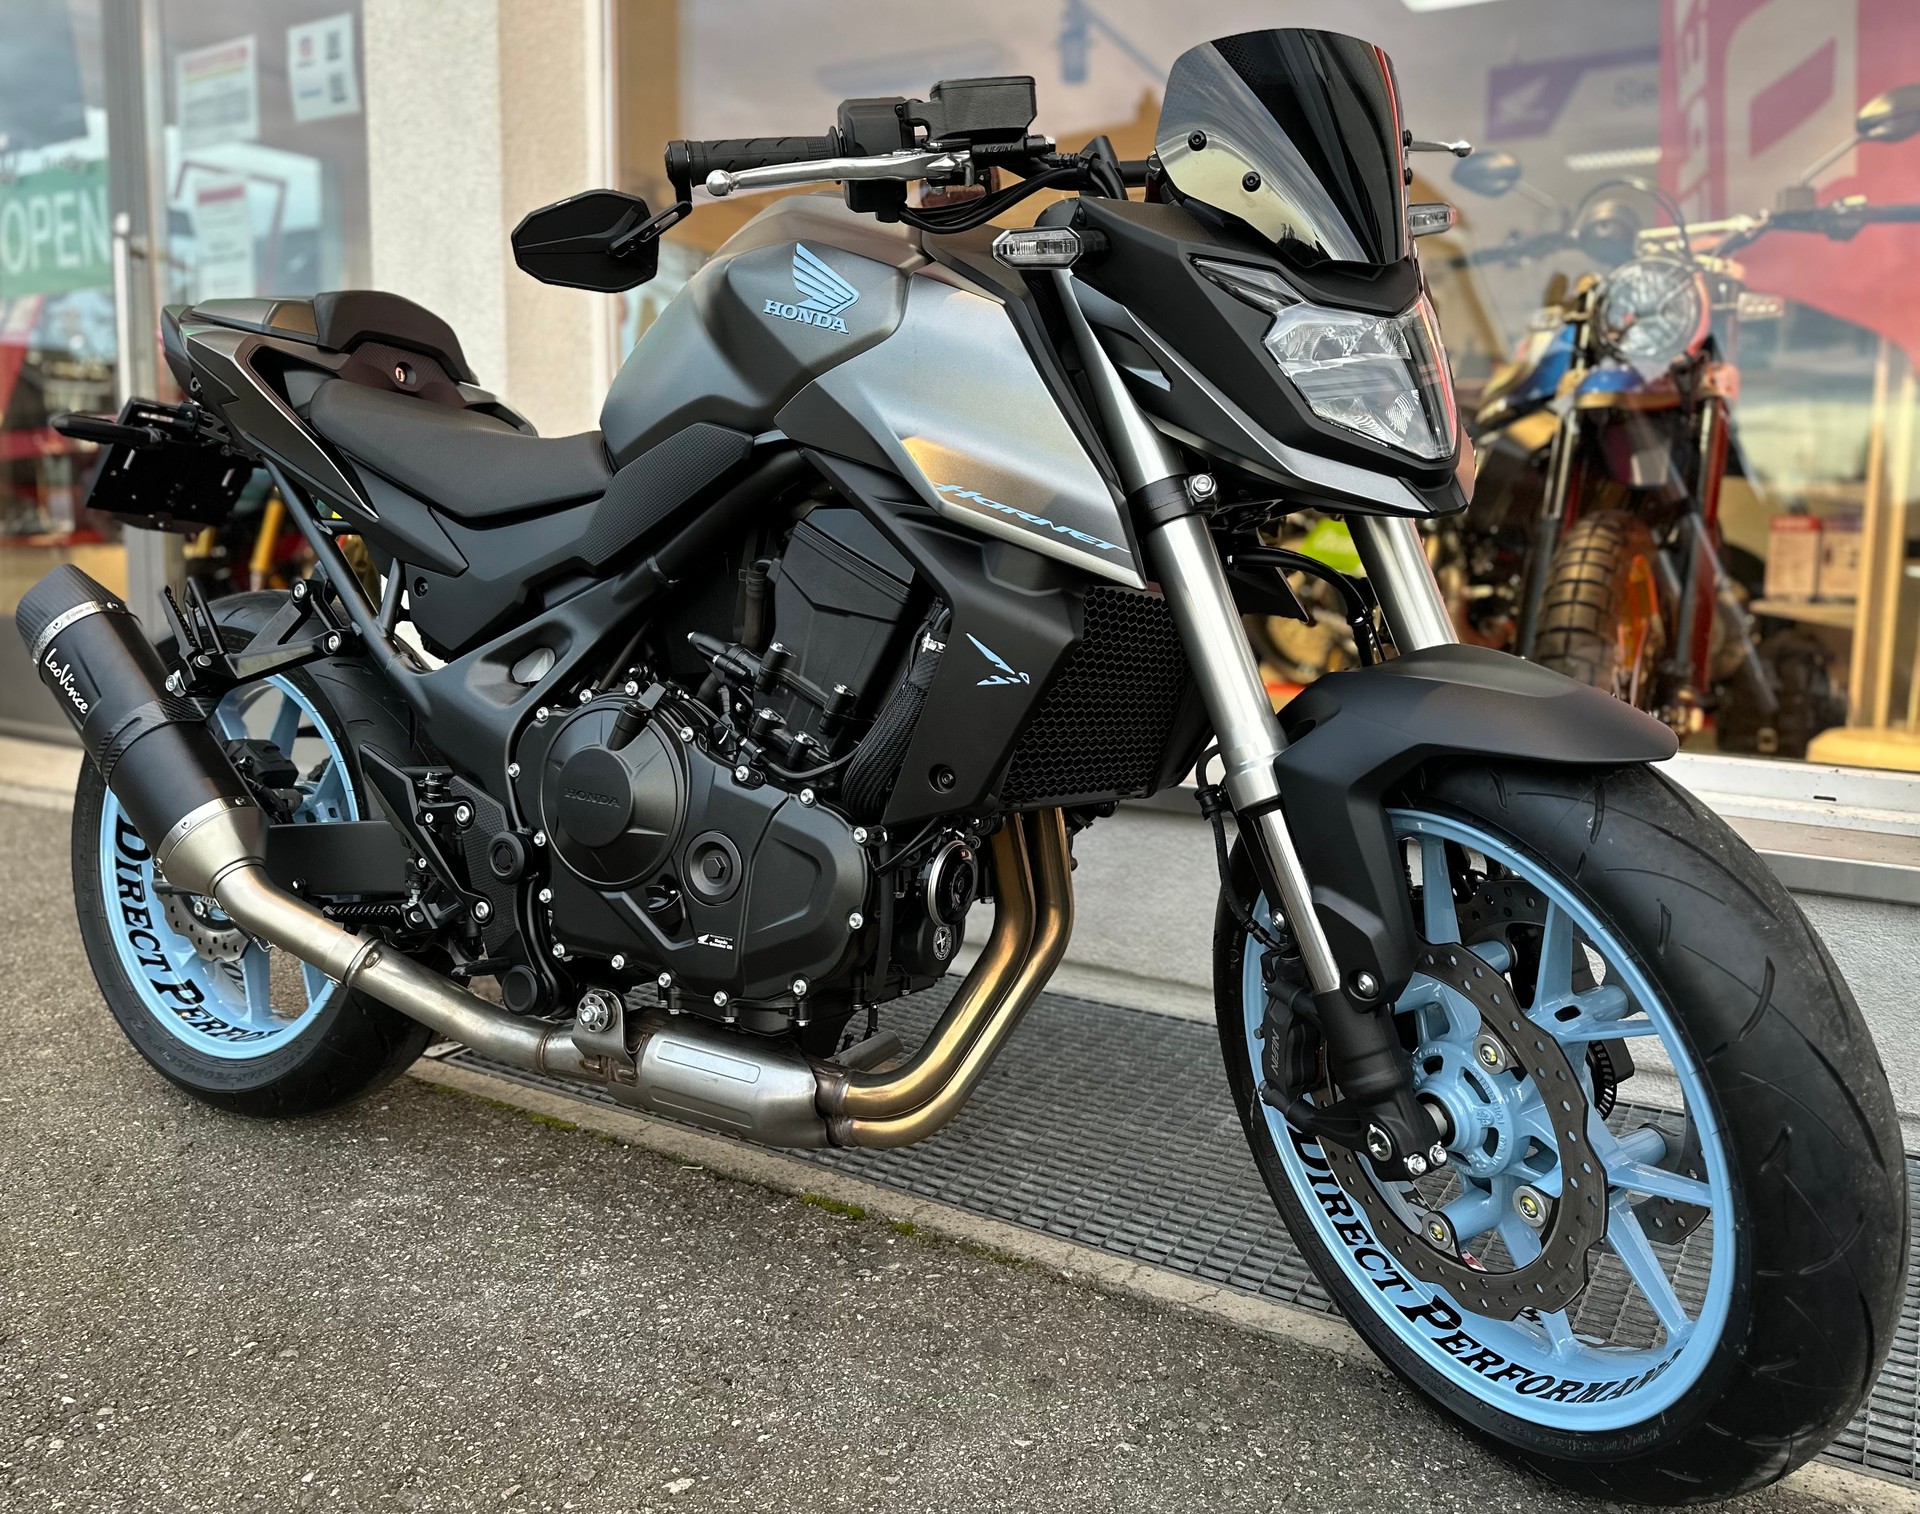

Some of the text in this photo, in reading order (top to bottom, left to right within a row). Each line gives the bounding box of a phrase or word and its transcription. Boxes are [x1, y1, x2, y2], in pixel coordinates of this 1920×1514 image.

[0, 185, 110, 275] OPEN
[763, 299, 850, 335] HONDA
[932, 482, 1131, 553] HORNET
[44, 647, 89, 714] LeoVince
[564, 787, 620, 808] HONDA
[115, 813, 172, 974] DIRECT
[1286, 1124, 1414, 1308] DIRECT
[1405, 1294, 1691, 1405] PERFORMAN
